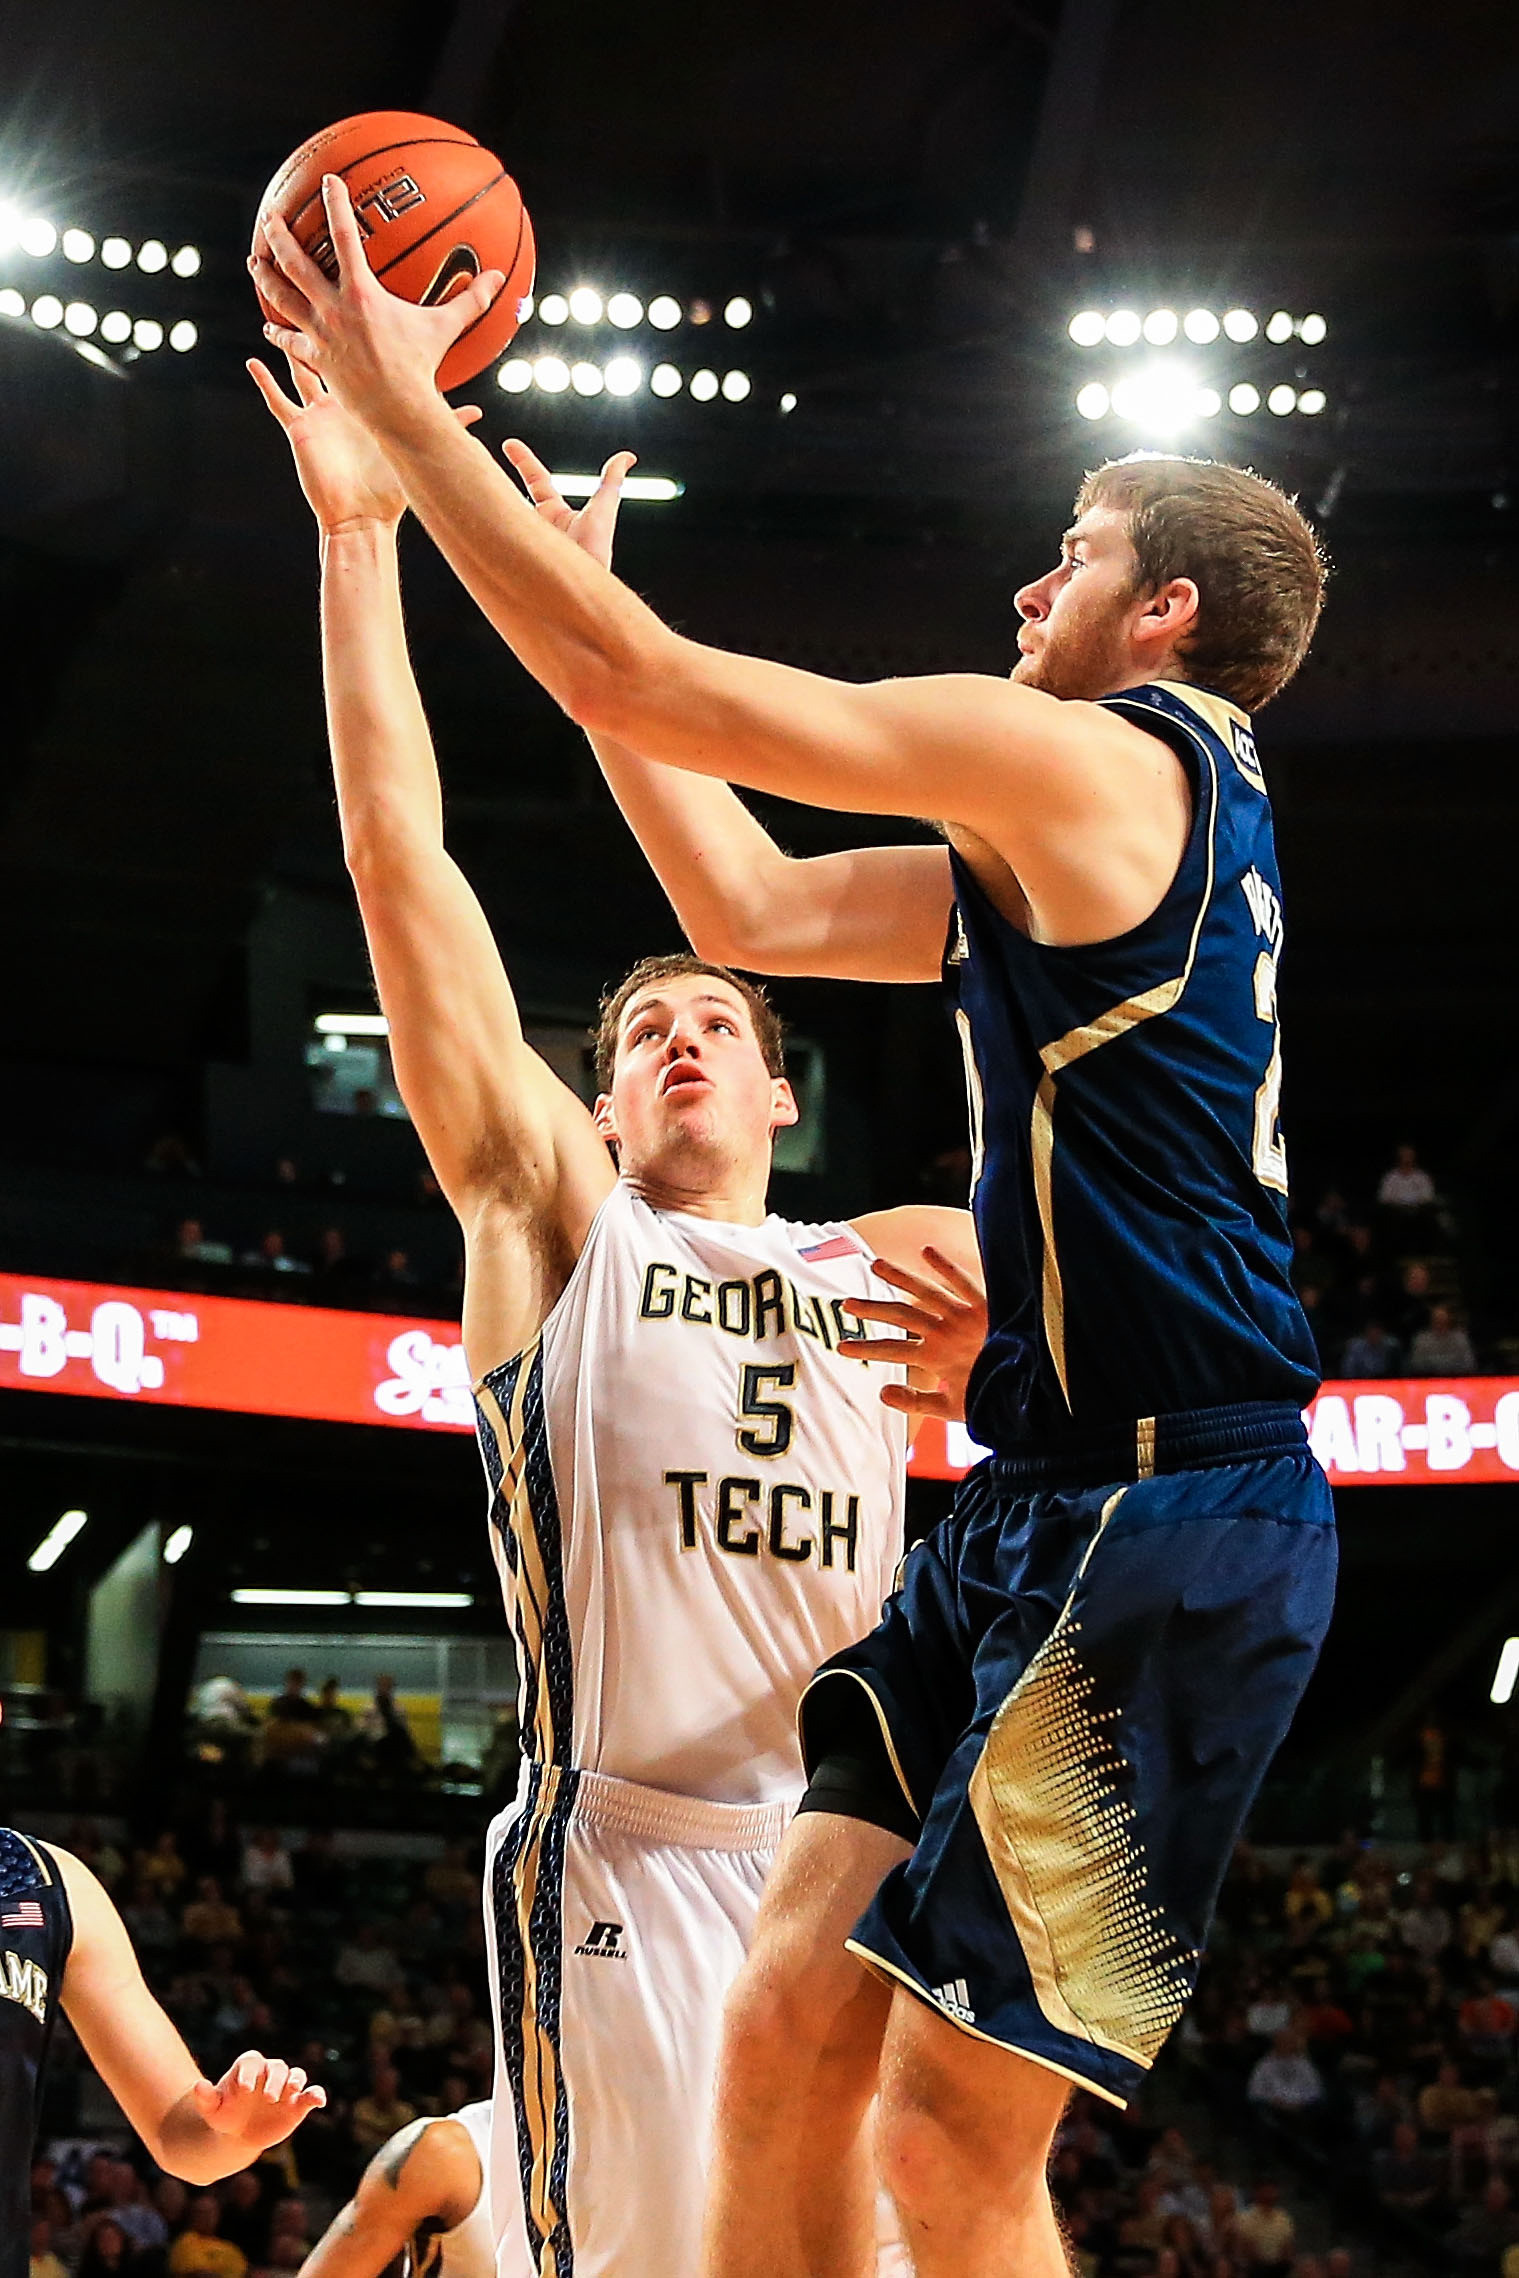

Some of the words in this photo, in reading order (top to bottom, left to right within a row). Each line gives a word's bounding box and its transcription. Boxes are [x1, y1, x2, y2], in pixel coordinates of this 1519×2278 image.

[735, 1359, 800, 1461] 5
[1300, 1391, 1519, 1473] AR-B-
[661, 1468, 862, 1573] TECH
[574, 1945, 628, 1960] RUSSELL
